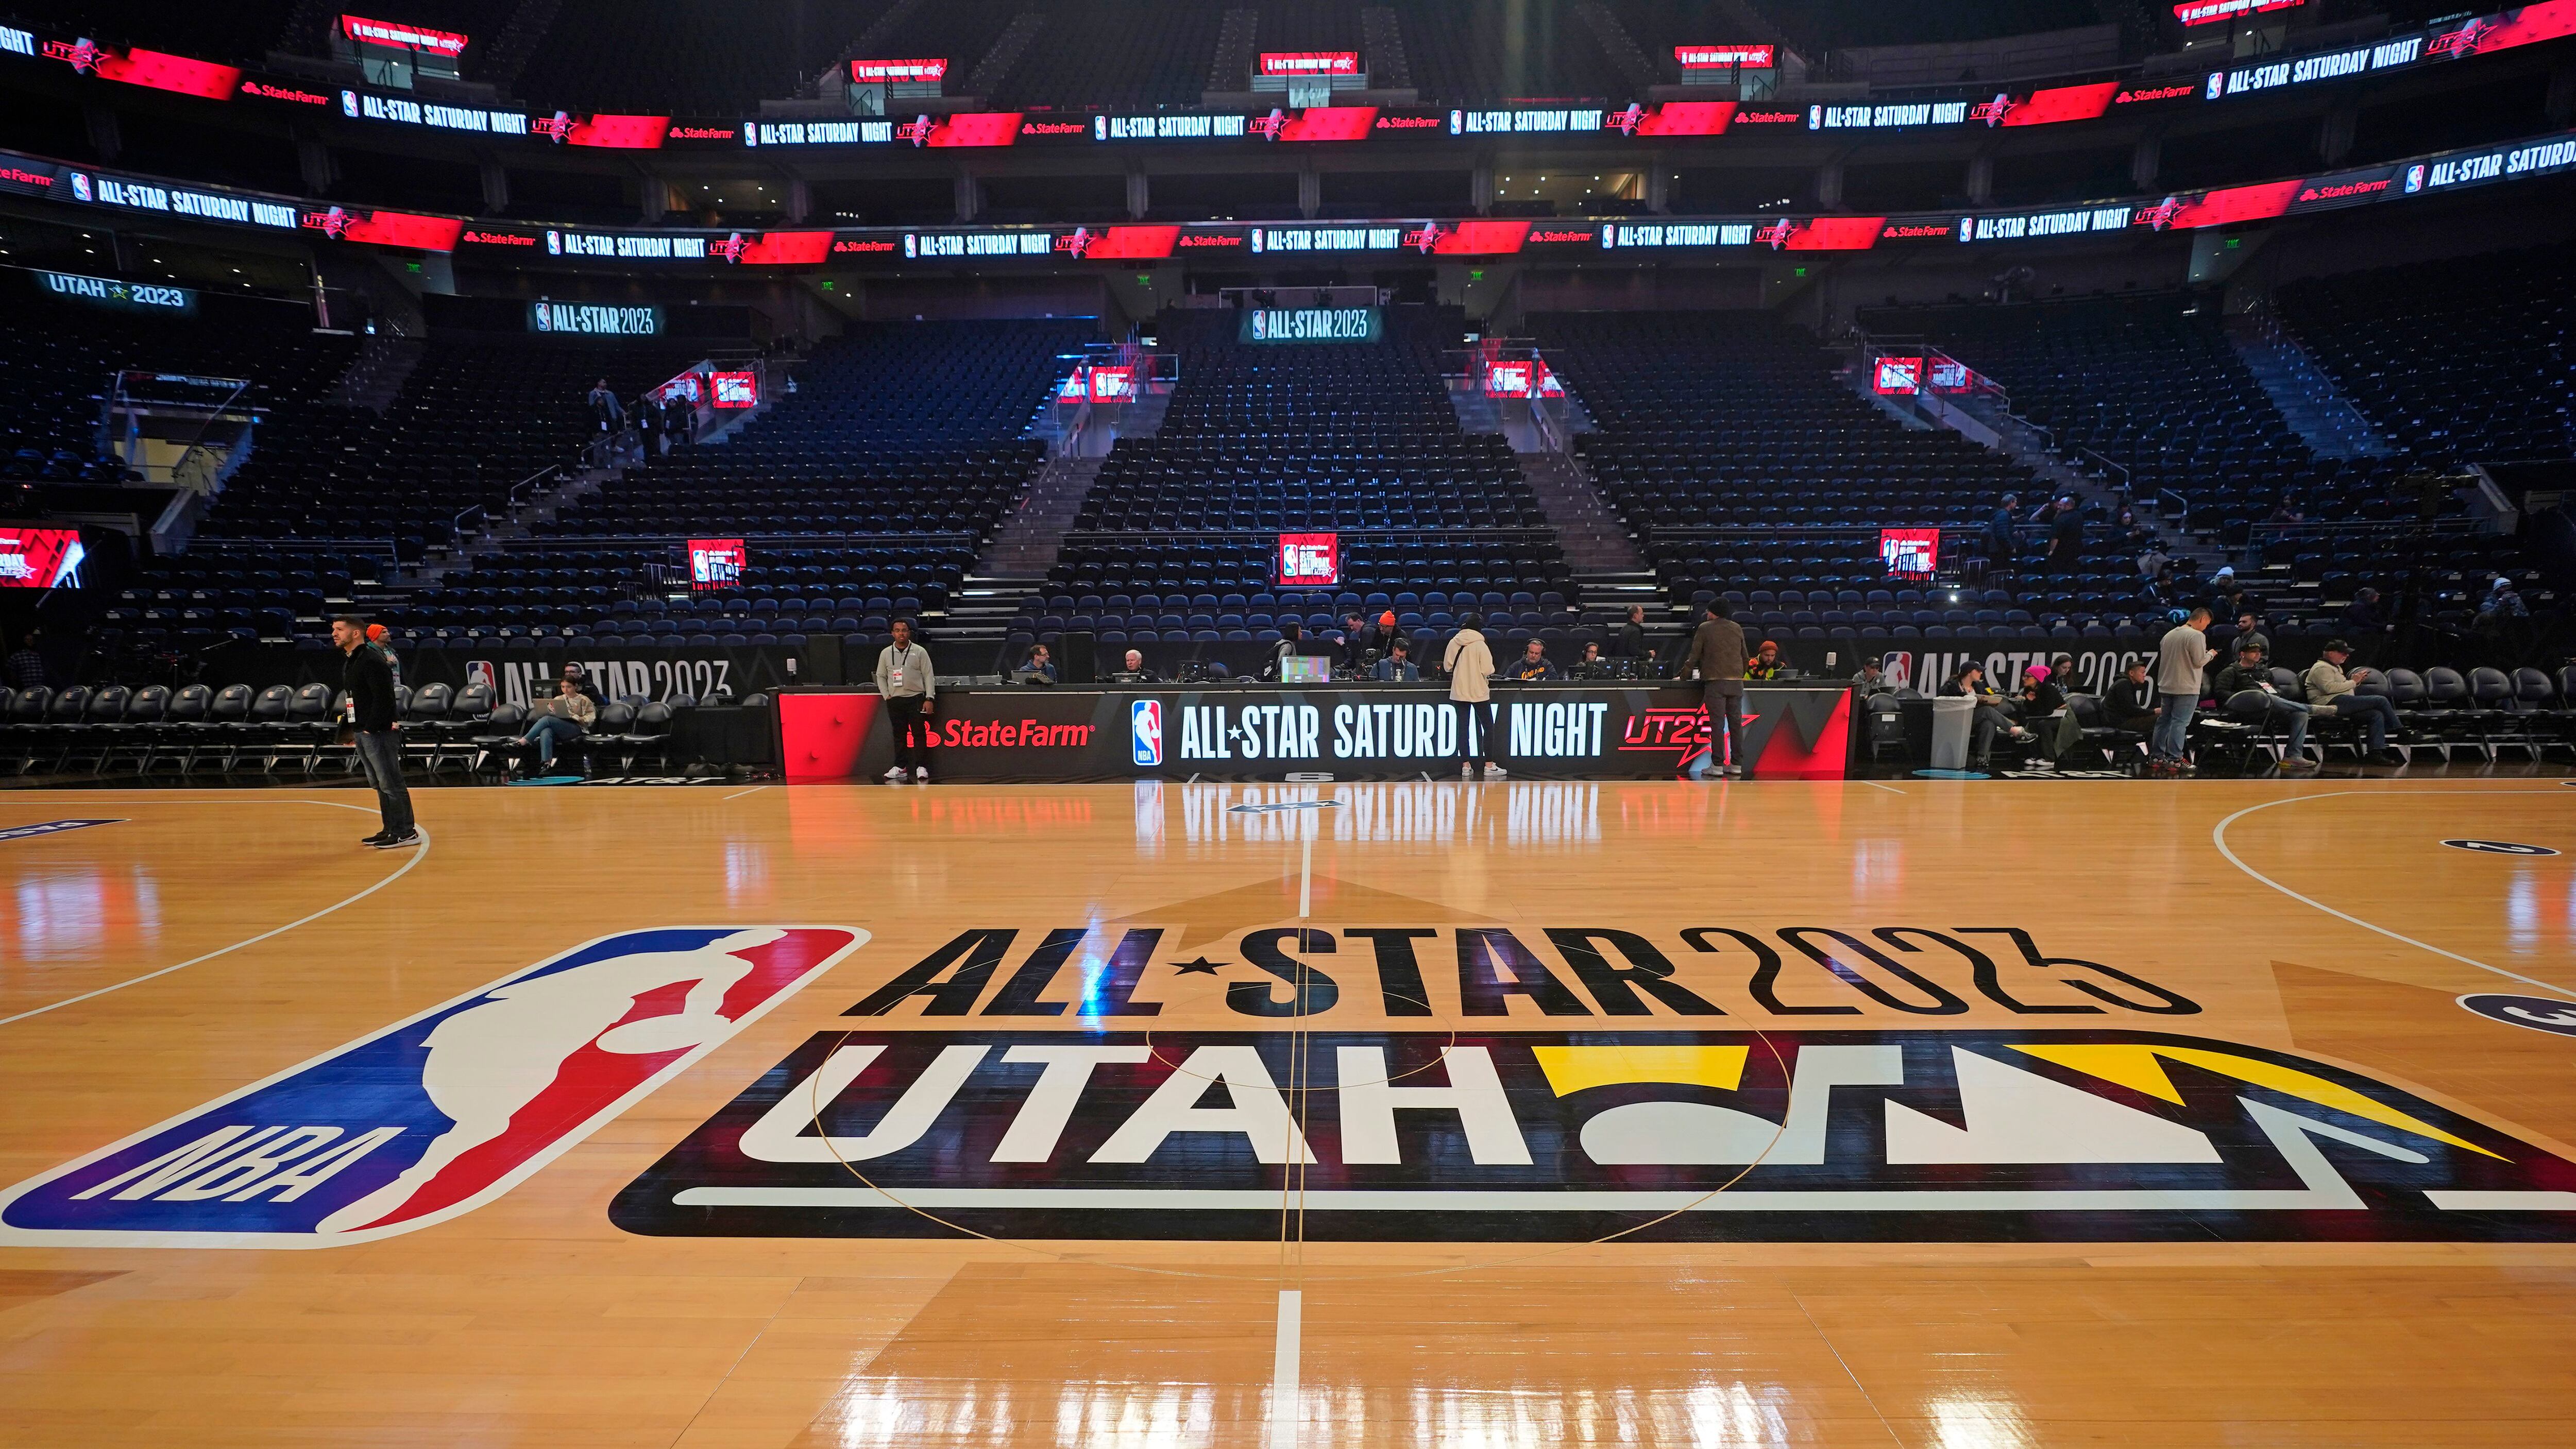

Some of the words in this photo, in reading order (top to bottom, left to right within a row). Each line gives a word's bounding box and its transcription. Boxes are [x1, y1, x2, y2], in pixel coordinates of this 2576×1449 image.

[0, 26, 35, 56] GHT
[2293, 49, 2369, 83] SATURDAY
[2371, 38, 2421, 69] NIGHT
[425, 105, 487, 131] SATURDAY
[490, 112, 526, 134] NIGHT
[1159, 116, 1211, 137] SATURDAY
[1213, 115, 1245, 135] NIGHT
[1515, 110, 1567, 131] SATURDAY
[1570, 110, 1602, 130] NIGHT
[1874, 105, 1930, 126] SATURDAY
[1932, 102, 1967, 125] NIGHT
[808, 123, 858, 143] SATURDAY
[861, 122, 892, 142] NIGHT
[173, 191, 249, 221] SATURDAY
[252, 203, 296, 228] NIGHT
[2028, 212, 2090, 236] SATURDAY
[2092, 208, 2130, 230] NIGHT
[618, 237, 670, 257] SATURDAY
[673, 238, 704, 257] NIGHT
[967, 234, 1017, 255] SATURDAY
[1021, 234, 1050, 253] NIGHT
[1314, 229, 1364, 249] SATURDAY
[1368, 229, 1399, 249] NIGHT
[1666, 226, 1718, 245] SATURDAY
[1721, 225, 1752, 245] NIGHT
[49, 274, 106, 298] UTAH
[131, 285, 184, 306] 2023
[620, 308, 654, 334] 2023
[1334, 310, 1367, 338] 2023
[1510, 703, 1607, 757] NIGHT
[1138, 750, 1151, 761] NBA
[1680, 927, 2202, 1015] 2023
[739, 1046, 1534, 1165] UTAH
[69, 1125, 408, 1203] NBA
